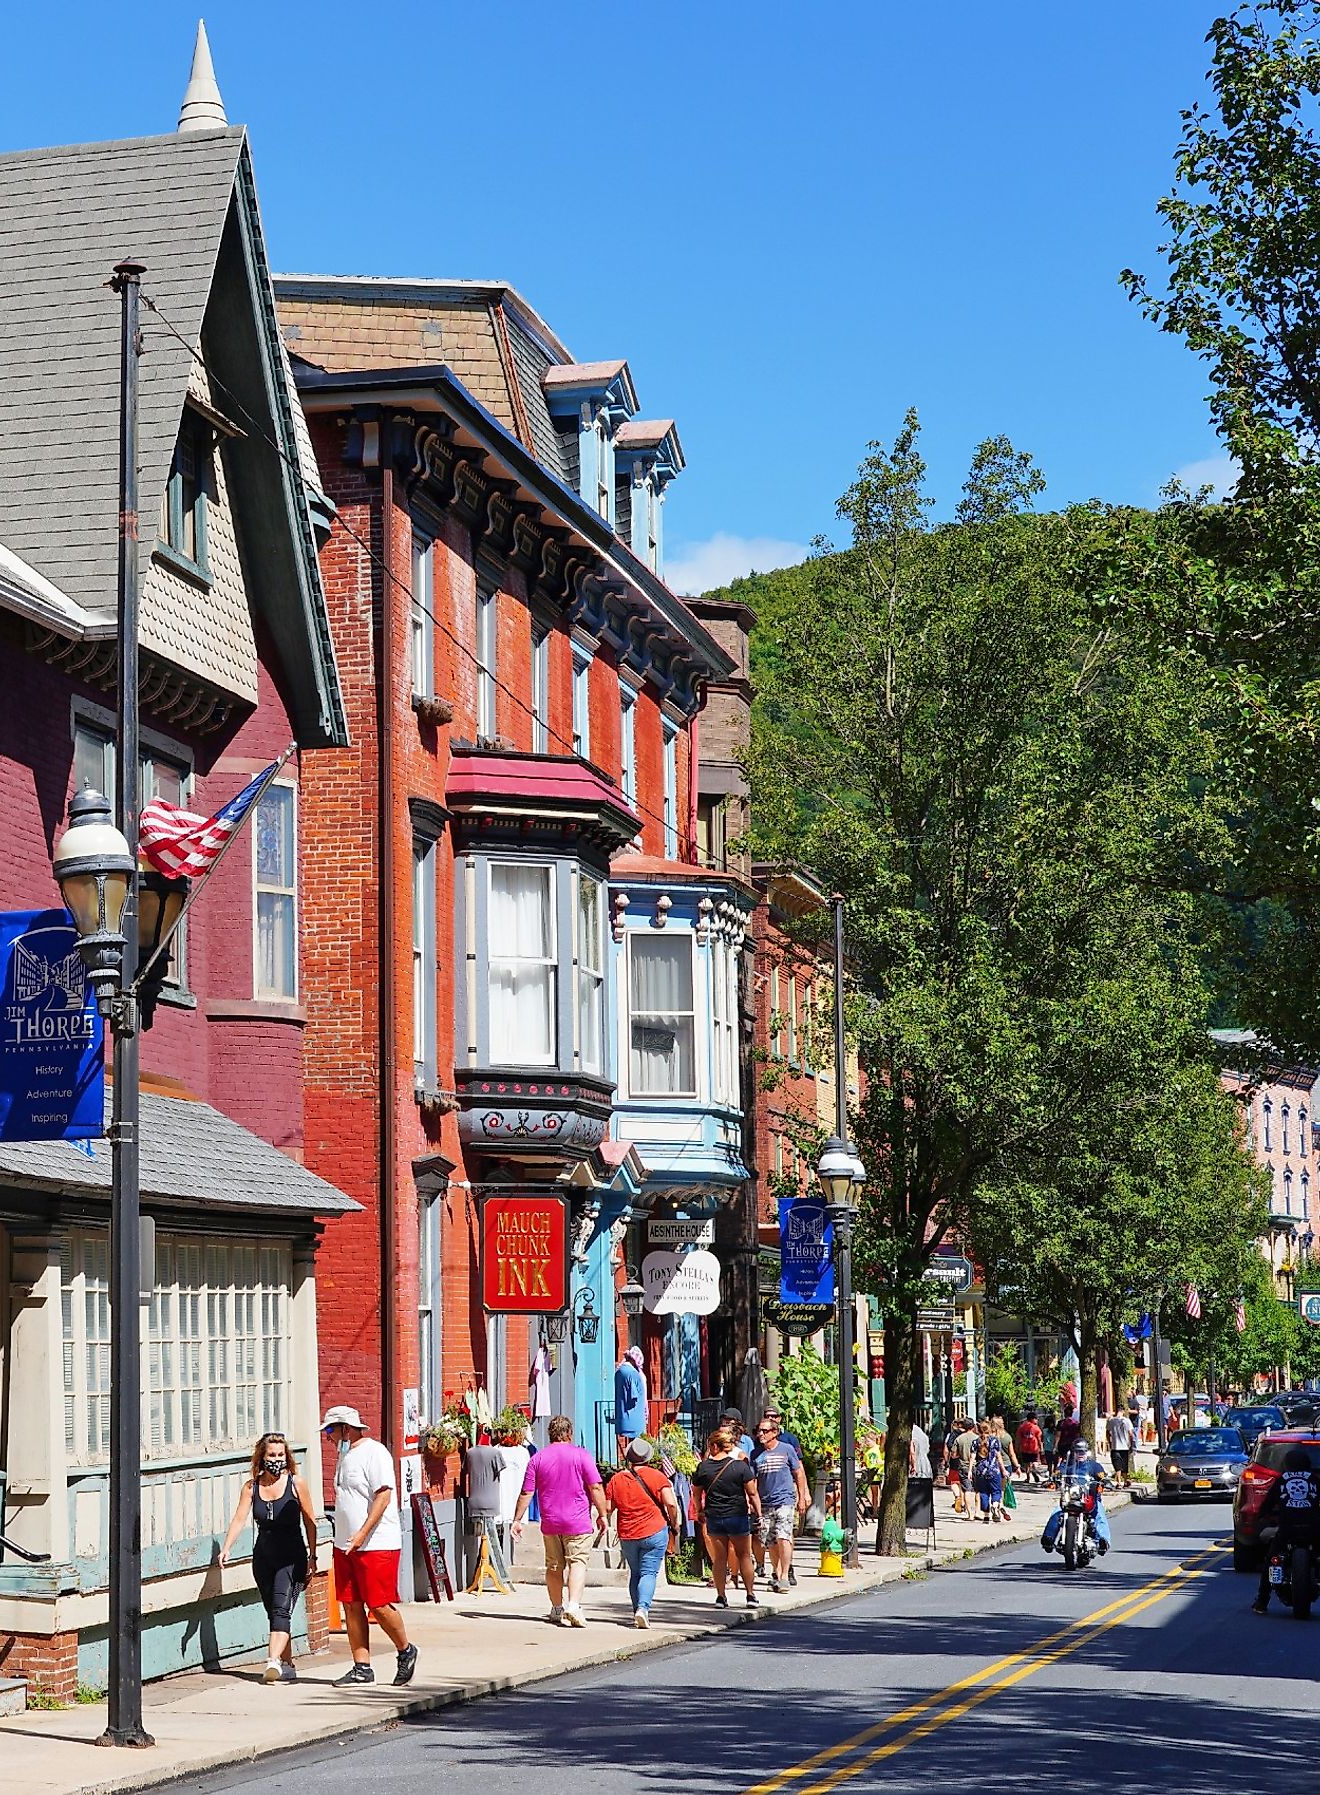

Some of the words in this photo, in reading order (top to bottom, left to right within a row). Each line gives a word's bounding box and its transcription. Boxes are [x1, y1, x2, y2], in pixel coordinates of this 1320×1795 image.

[4, 1006, 26, 1021] JIM
[10, 1009, 95, 1043] THORPE
[5, 1042, 94, 1053] PENNSYLVANIA
[35, 1064, 64, 1076] History
[26, 1088, 73, 1099] Adventure
[31, 1112, 68, 1124] Inspiring
[496, 1212, 551, 1233] MAUCH
[496, 1234, 551, 1256] CHUNK
[789, 1243, 829, 1260] THORPE
[497, 1258, 552, 1297] INK
[648, 1266, 672, 1284] TONY
[662, 1281, 701, 1290] ENCORE
[776, 1309, 815, 1321] House
